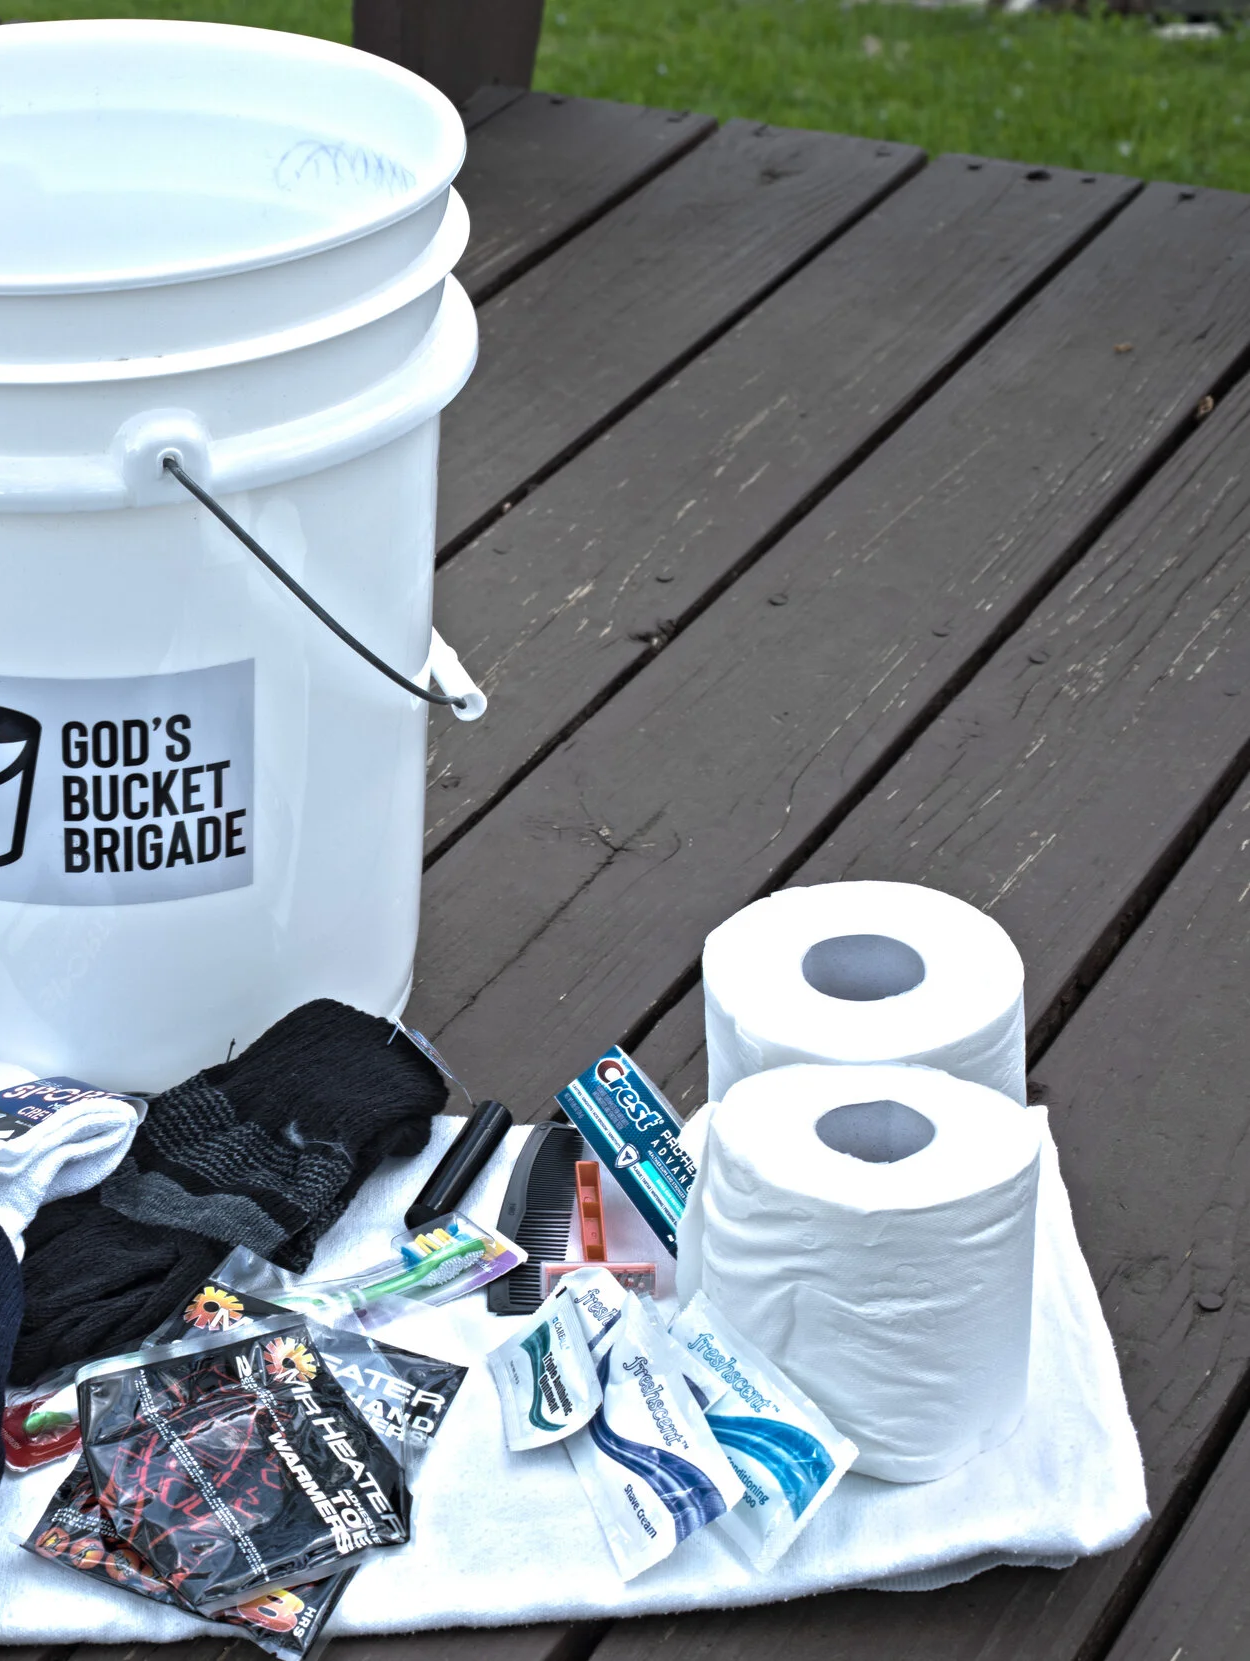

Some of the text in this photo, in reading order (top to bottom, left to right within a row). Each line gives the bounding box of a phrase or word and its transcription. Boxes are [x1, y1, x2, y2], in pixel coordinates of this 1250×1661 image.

[60, 714, 192, 769] GOD'S
[62, 760, 231, 823] BUCKET
[63, 808, 247, 874] BRIGADE
[235, 1356, 253, 1382] 2
[327, 1356, 445, 1414] EATER
[535, 1374, 562, 1413] Ointment
[541, 1352, 576, 1415] Triple Antibiotic
[687, 1332, 772, 1413] freshscent
[622, 1355, 683, 1447] freshscent
[137, 1369, 149, 1384] AIR
[206, 1481, 216, 1495] ALL
[217, 1496, 239, 1529] NATURAL
[277, 1365, 323, 1420] MR
[317, 1416, 406, 1545] HEATER
[268, 1432, 354, 1555] WARMERS
[337, 1489, 372, 1550] TOE
[343, 1487, 382, 1545] ADHESIVE
[624, 1484, 657, 1539] Shave Cream
[292, 1606, 317, 1638] HRS
